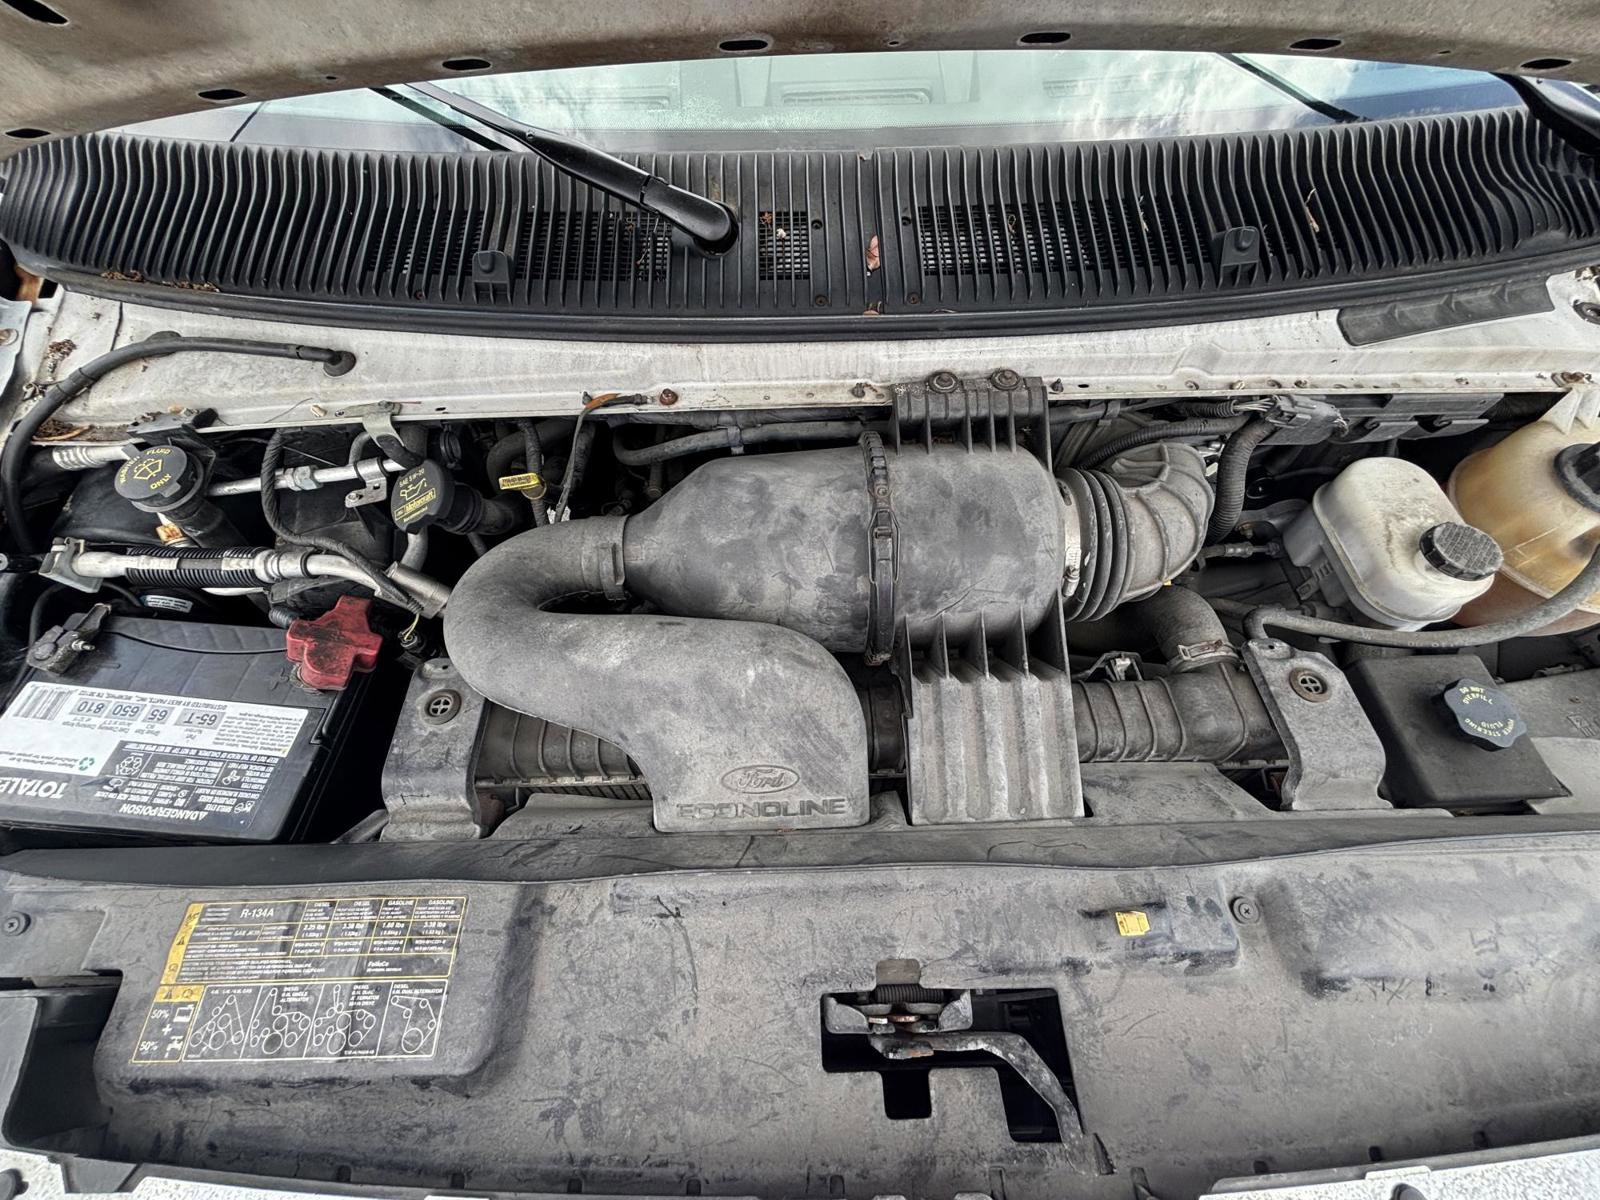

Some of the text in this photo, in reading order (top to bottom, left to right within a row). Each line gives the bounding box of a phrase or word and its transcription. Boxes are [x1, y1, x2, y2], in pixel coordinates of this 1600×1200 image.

[150, 474, 172, 489] ONLY
[77, 701, 105, 714] 810
[112, 704, 140, 717] 650
[148, 709, 169, 721] 65
[183, 712, 218, 726] 65-T
[737, 769, 784, 790] Ford
[676, 798, 846, 819] ECONOLINE
[239, 908, 275, 919] R-134A
[150, 1009, 169, 1019] 50%
[139, 1041, 158, 1051] 50%
